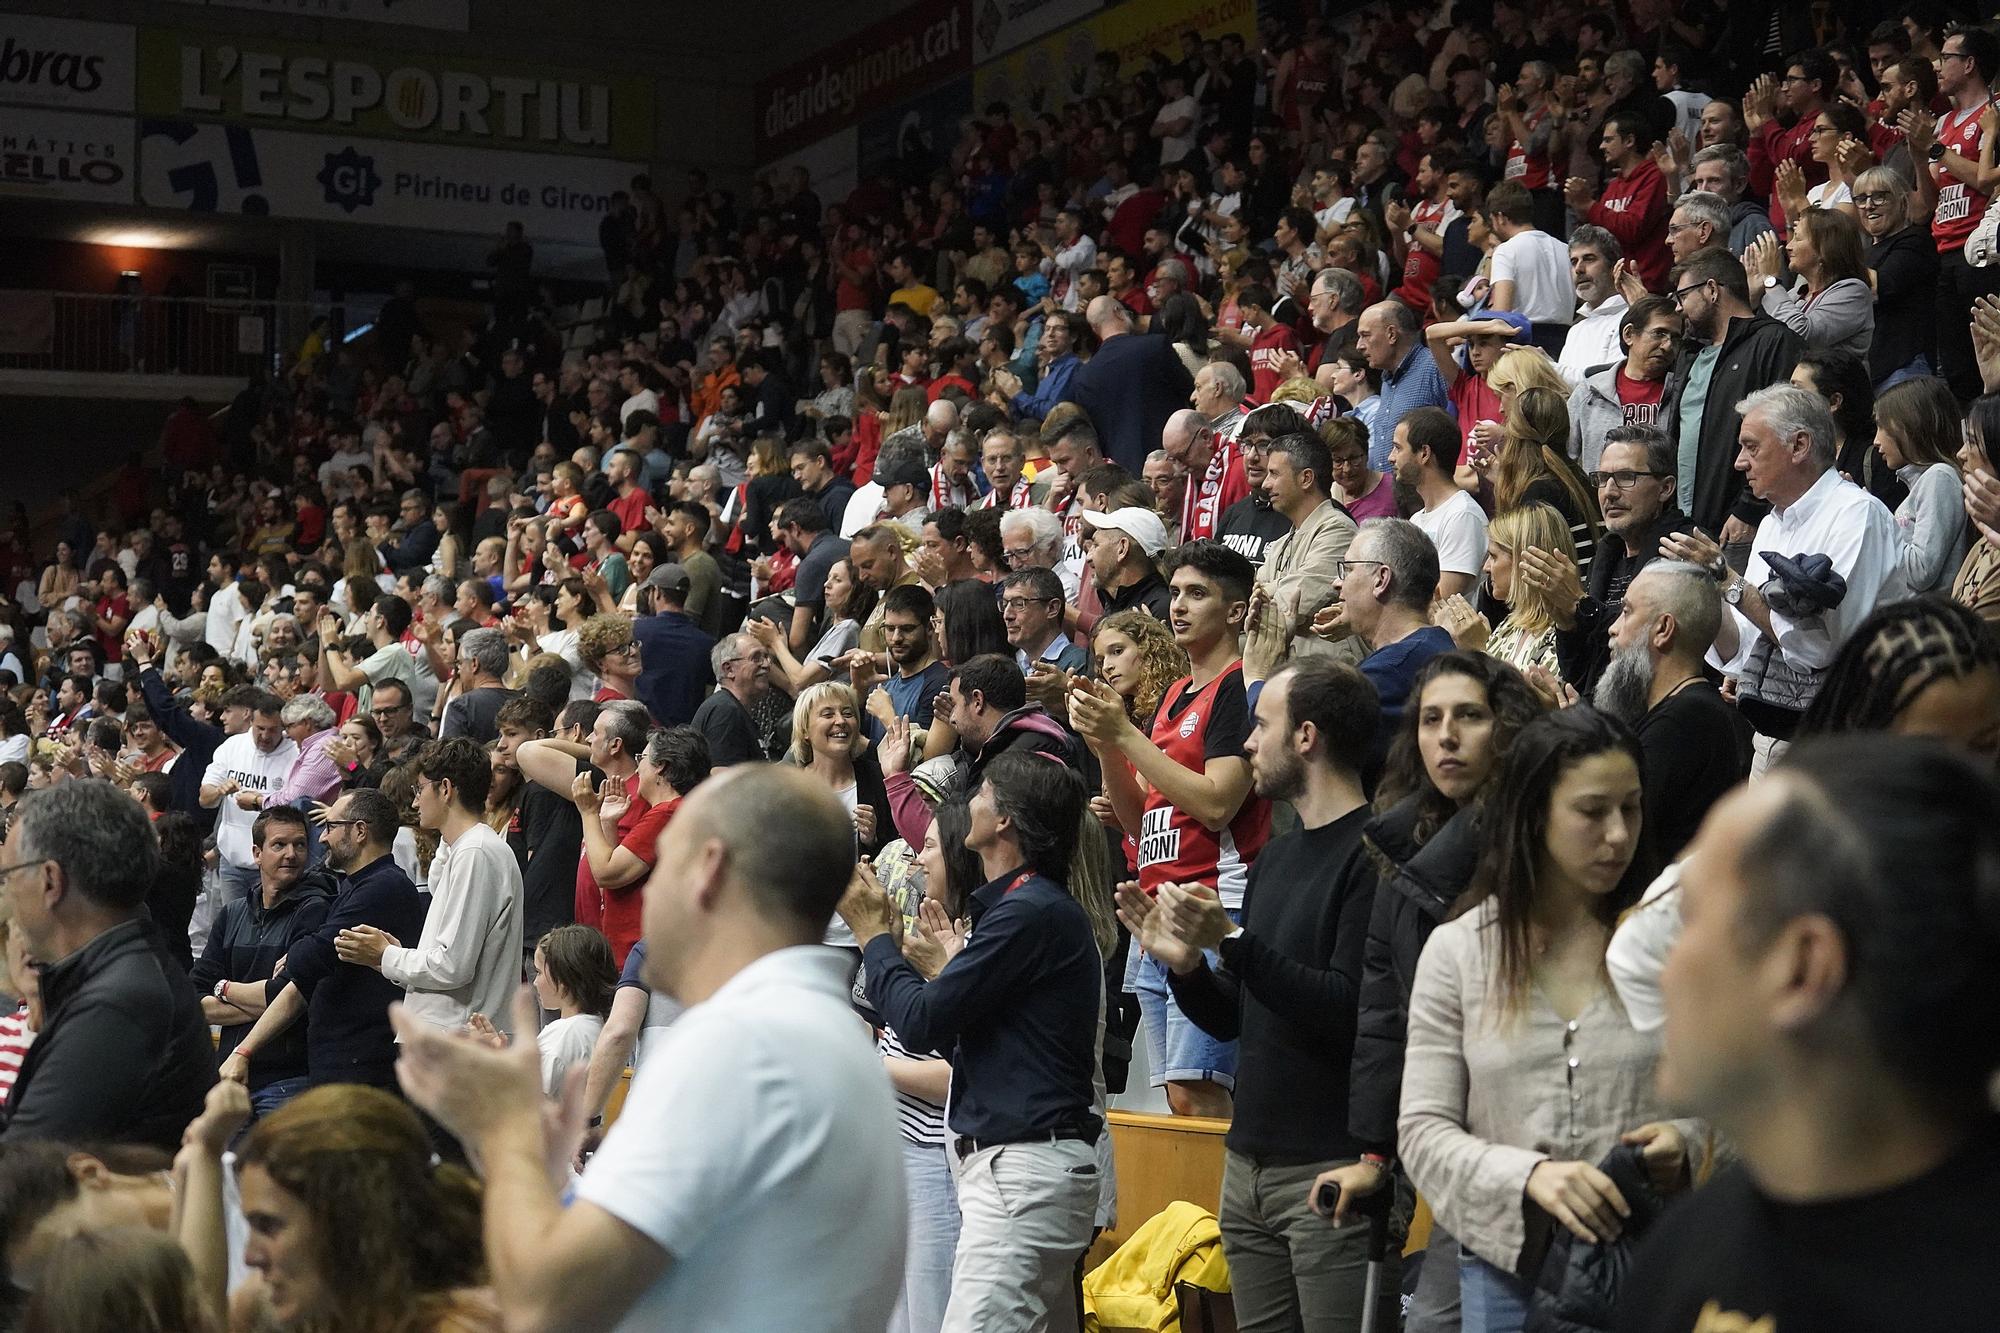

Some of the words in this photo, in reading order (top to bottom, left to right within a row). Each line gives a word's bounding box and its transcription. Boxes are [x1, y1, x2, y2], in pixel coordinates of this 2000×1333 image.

[181, 45, 612, 146] L'ESPORTIU
[764, 7, 961, 138] diaridegirona.cat
[0, 153, 124, 184] ELLO
[395, 171, 490, 204] Pirineu
[501, 181, 531, 206] de
[542, 184, 612, 213] Giron
